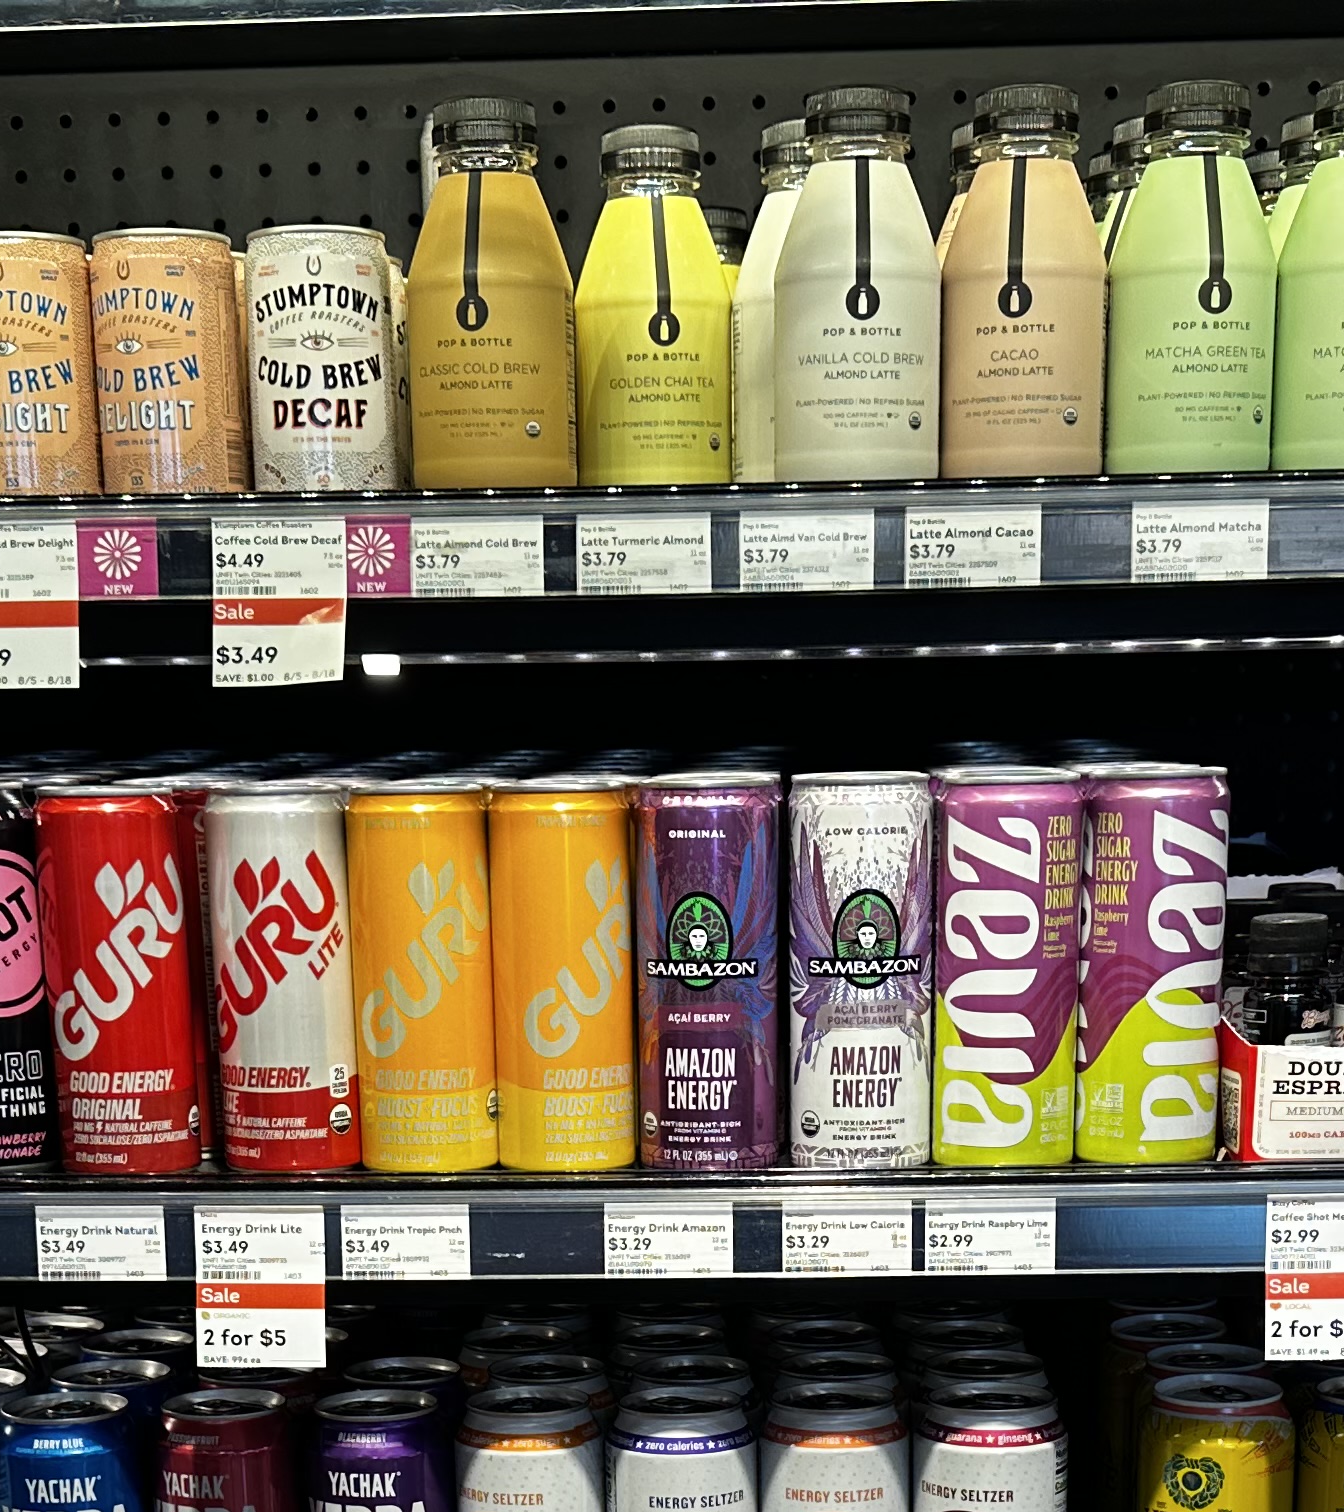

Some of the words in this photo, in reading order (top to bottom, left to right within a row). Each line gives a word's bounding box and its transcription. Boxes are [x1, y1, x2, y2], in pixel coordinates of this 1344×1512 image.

[256, 283, 379, 323] STUMPTOWN
[823, 328, 845, 337] POP
[849, 328, 857, 337] &
[861, 326, 902, 337] BOTTLE
[798, 353, 849, 366] VANILLA
[853, 352, 887, 365] COLD
[891, 353, 925, 366] BREW
[258, 356, 316, 389] COLD
[322, 354, 382, 390] BREW
[824, 370, 867, 381] ALMOND
[870, 370, 901, 380] LATTE
[274, 399, 369, 429] DECAF
[909, 528, 940, 539] Latte
[944, 527, 992, 539] Almond
[994, 527, 1034, 539] Cacao
[909, 545, 955, 560] $3.79
[216, 646, 278, 665] $3.49
[1046, 816, 1073, 838] ZERO
[1046, 840, 1076, 861] SUGAR
[56, 854, 184, 1061] GURU
[308, 920, 345, 981] LITE
[647, 958, 757, 978] SAMBAZON
[941, 814, 1041, 1147] zevia
[667, 1010, 690, 1023] AÇAÍ
[694, 1011, 731, 1023] BERRY
[665, 1047, 736, 1076] AMAZON
[70, 1070, 110, 1093] GOOD
[112, 1069, 174, 1092] ENERGY
[667, 1079, 737, 1111] ENERGY
[72, 1098, 143, 1120] ORIGINAL
[201, 1225, 242, 1236] Energy
[245, 1224, 277, 1234] Drink
[280, 1223, 302, 1234] Lite
[202, 1240, 248, 1255] $3.49
[201, 1288, 240, 1304] Sale
[203, 1330, 214, 1345] 2
[221, 1329, 254, 1346] for
[260, 1328, 287, 1347] $5
[25, 1475, 98, 1504] YACHAK
[648, 1494, 697, 1510] ENERGY
[700, 1490, 745, 1508] SELTZER
